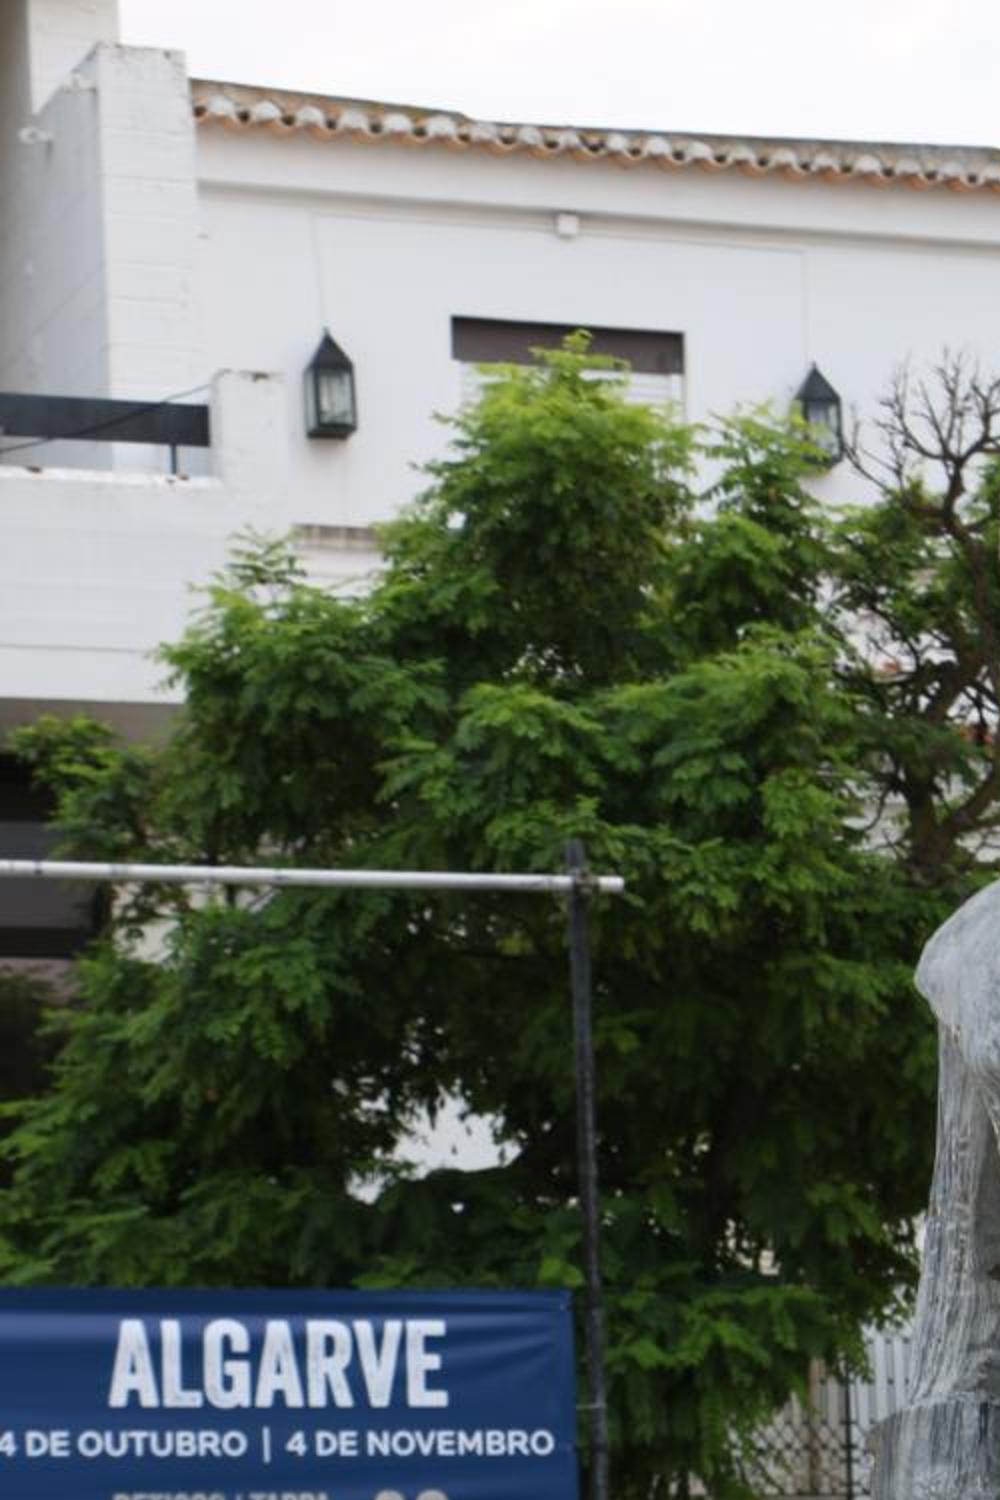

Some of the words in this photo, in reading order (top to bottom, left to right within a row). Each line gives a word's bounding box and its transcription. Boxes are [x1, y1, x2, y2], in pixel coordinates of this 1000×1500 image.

[108, 1318, 449, 1408] ALGARVE
[25, 1431, 70, 1457] DE
[77, 1430, 248, 1457] OUTUBRO
[285, 1430, 307, 1456] 4
[316, 1430, 358, 1457] DE
[367, 1429, 555, 1457] NOVEMBRO
